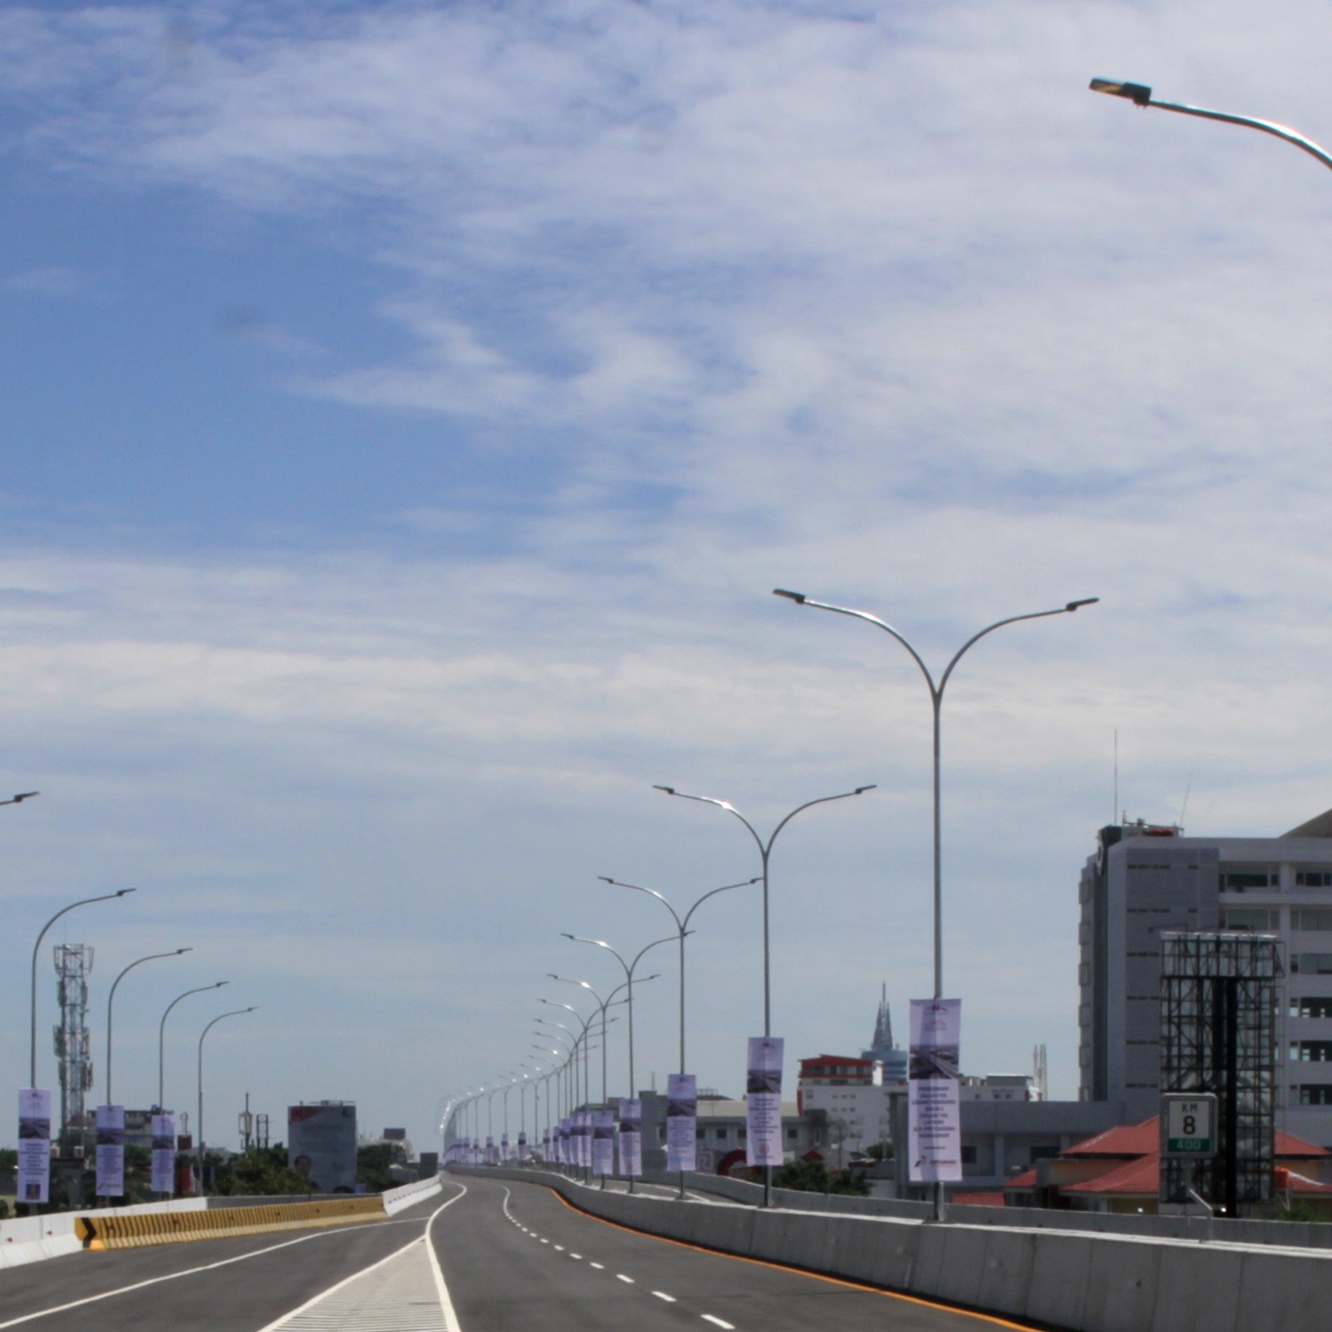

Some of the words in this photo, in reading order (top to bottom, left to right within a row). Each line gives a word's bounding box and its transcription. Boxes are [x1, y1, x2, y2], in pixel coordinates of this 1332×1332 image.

[1181, 1103, 1198, 1113] KM
[1183, 1115, 1196, 1135] 8
[1176, 1139, 1202, 1150] 400
